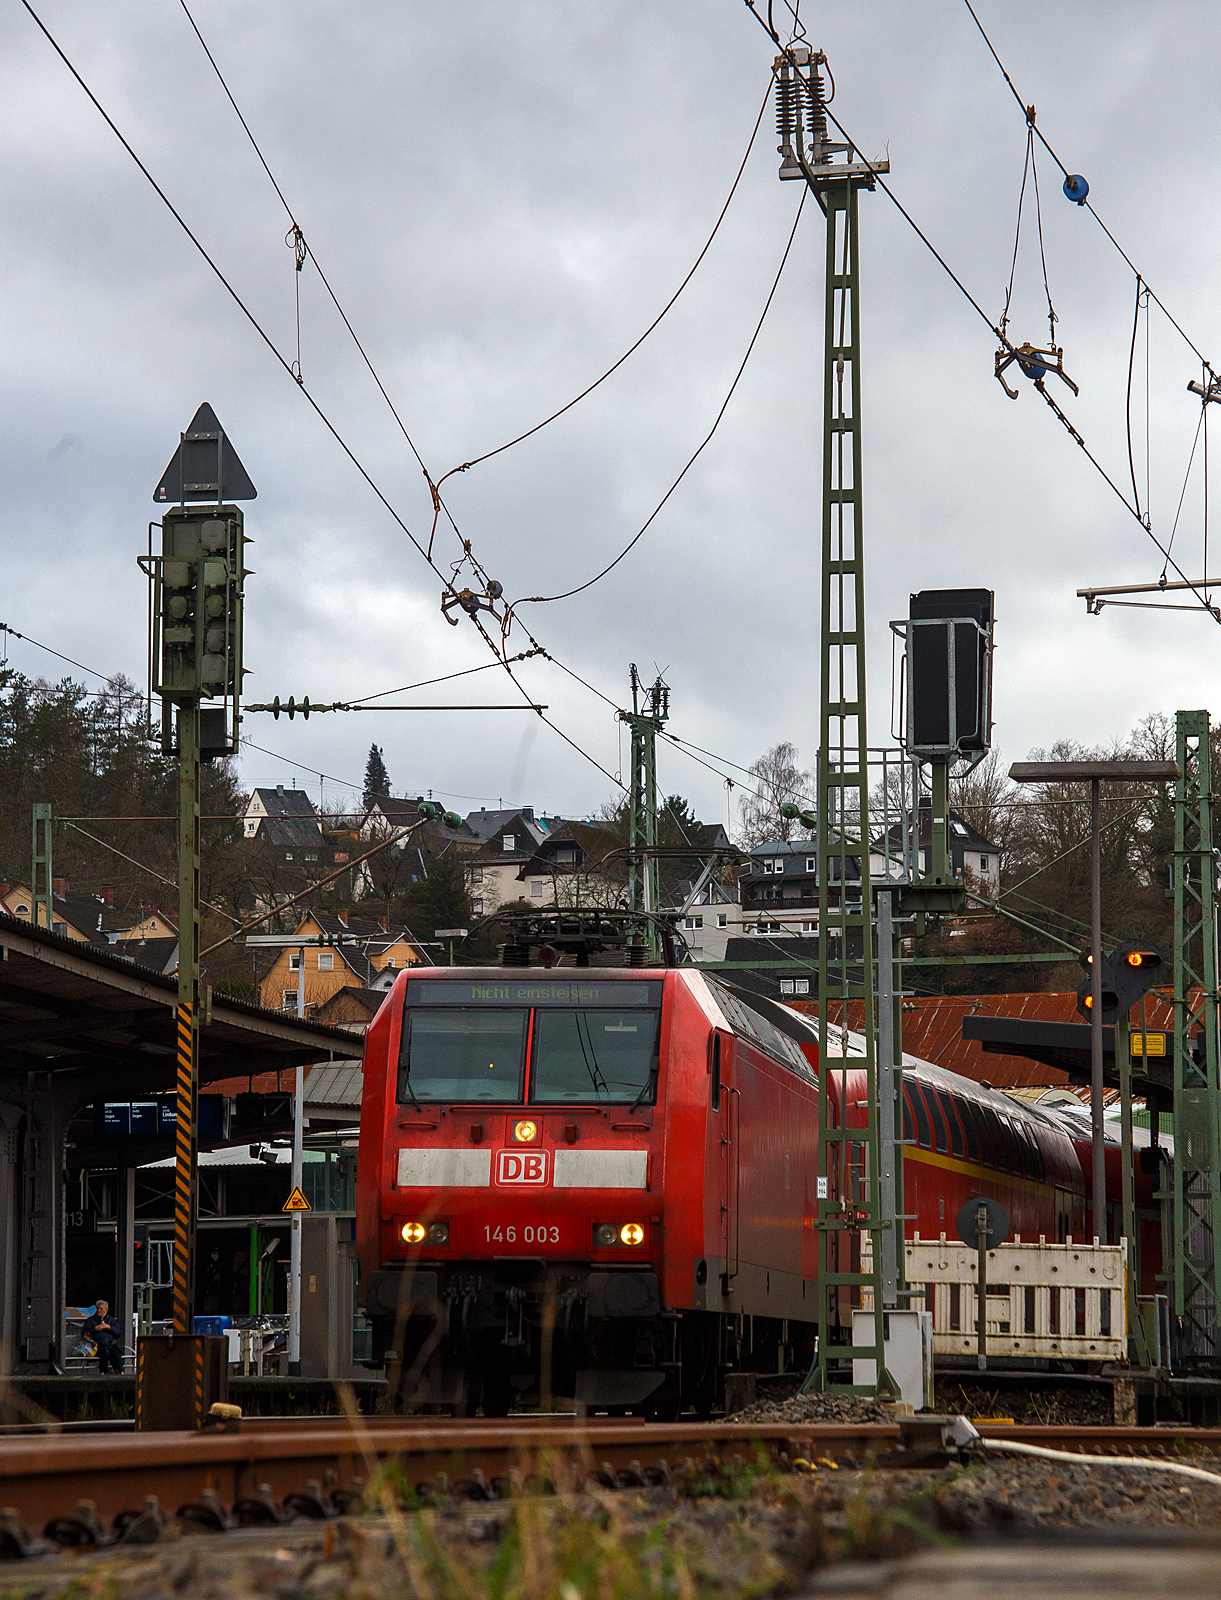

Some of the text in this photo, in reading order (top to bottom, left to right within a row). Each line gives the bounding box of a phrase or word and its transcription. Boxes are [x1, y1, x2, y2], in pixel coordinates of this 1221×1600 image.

[471, 986, 599, 1000] Nicht einsteigen
[502, 1155, 542, 1180] DB
[484, 1225, 560, 1243] 146 003
